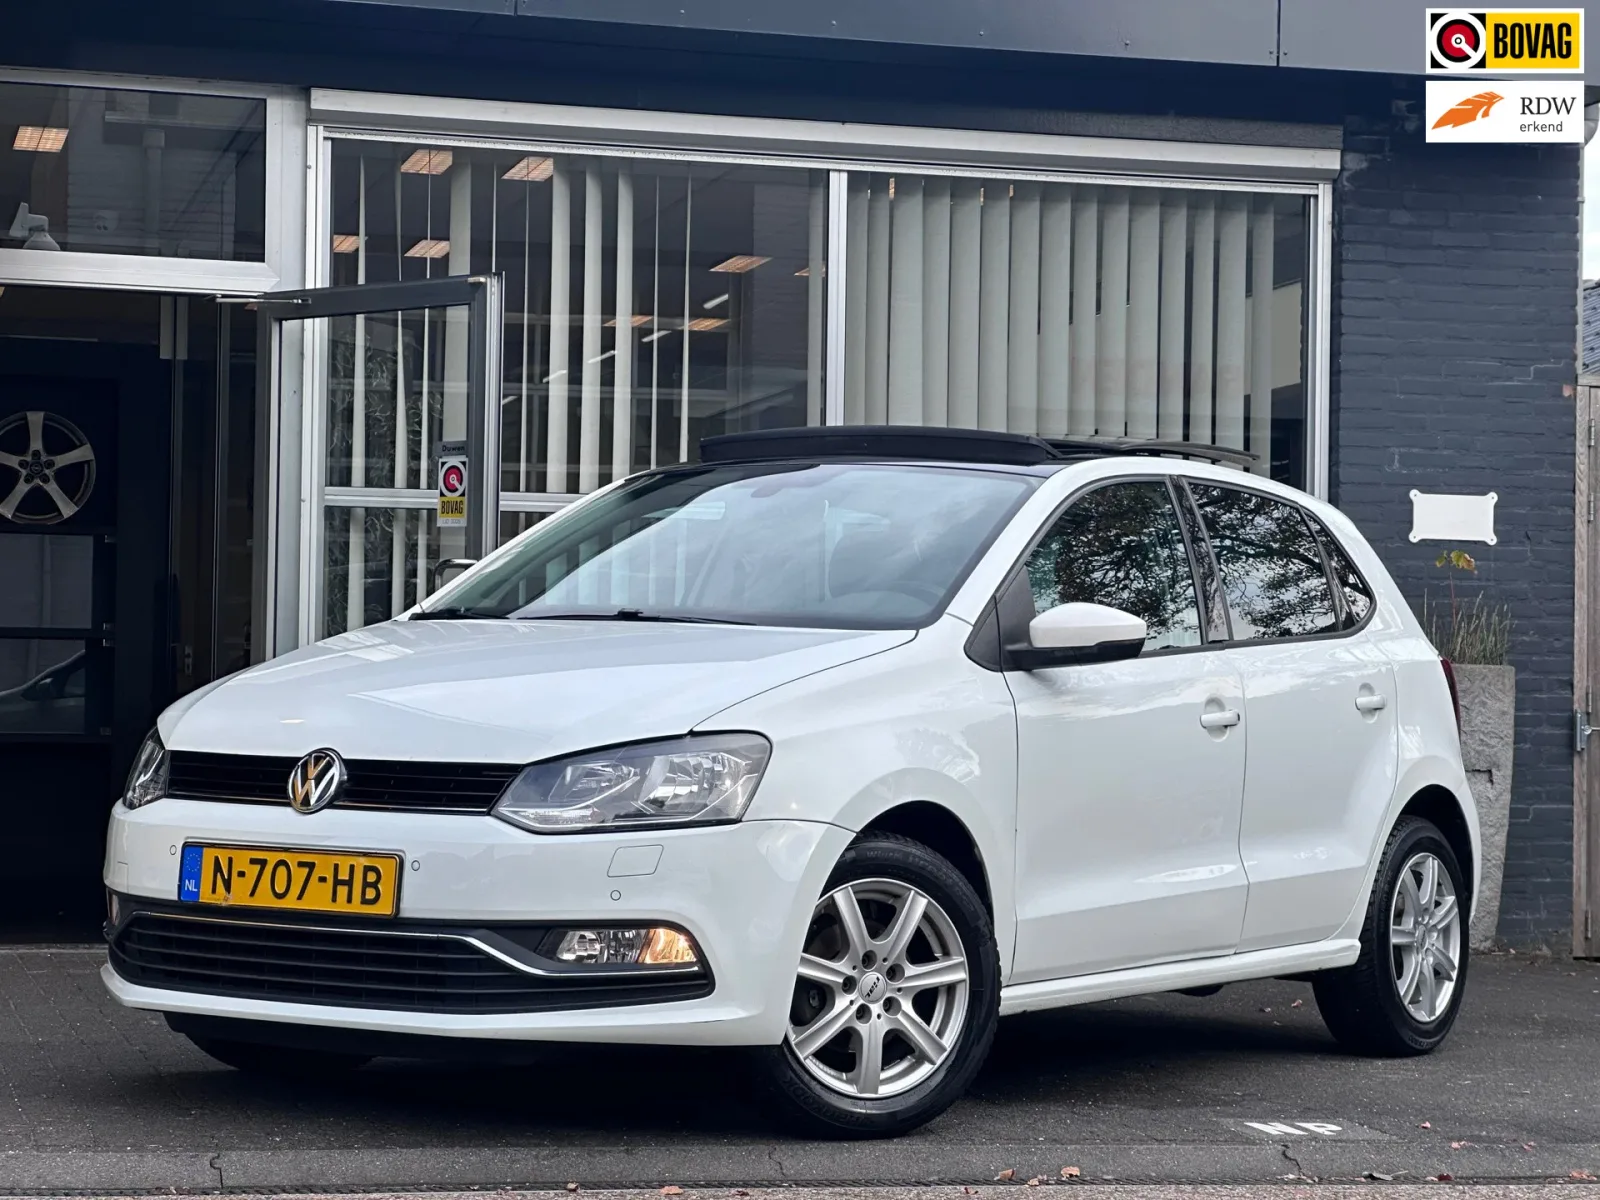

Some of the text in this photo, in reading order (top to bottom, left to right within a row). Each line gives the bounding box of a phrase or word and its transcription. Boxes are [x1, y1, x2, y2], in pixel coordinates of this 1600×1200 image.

[441, 501, 464, 514] BOVAG
[185, 855, 383, 906] NL N-707-HB
[1243, 1122, 1343, 1136] NP
